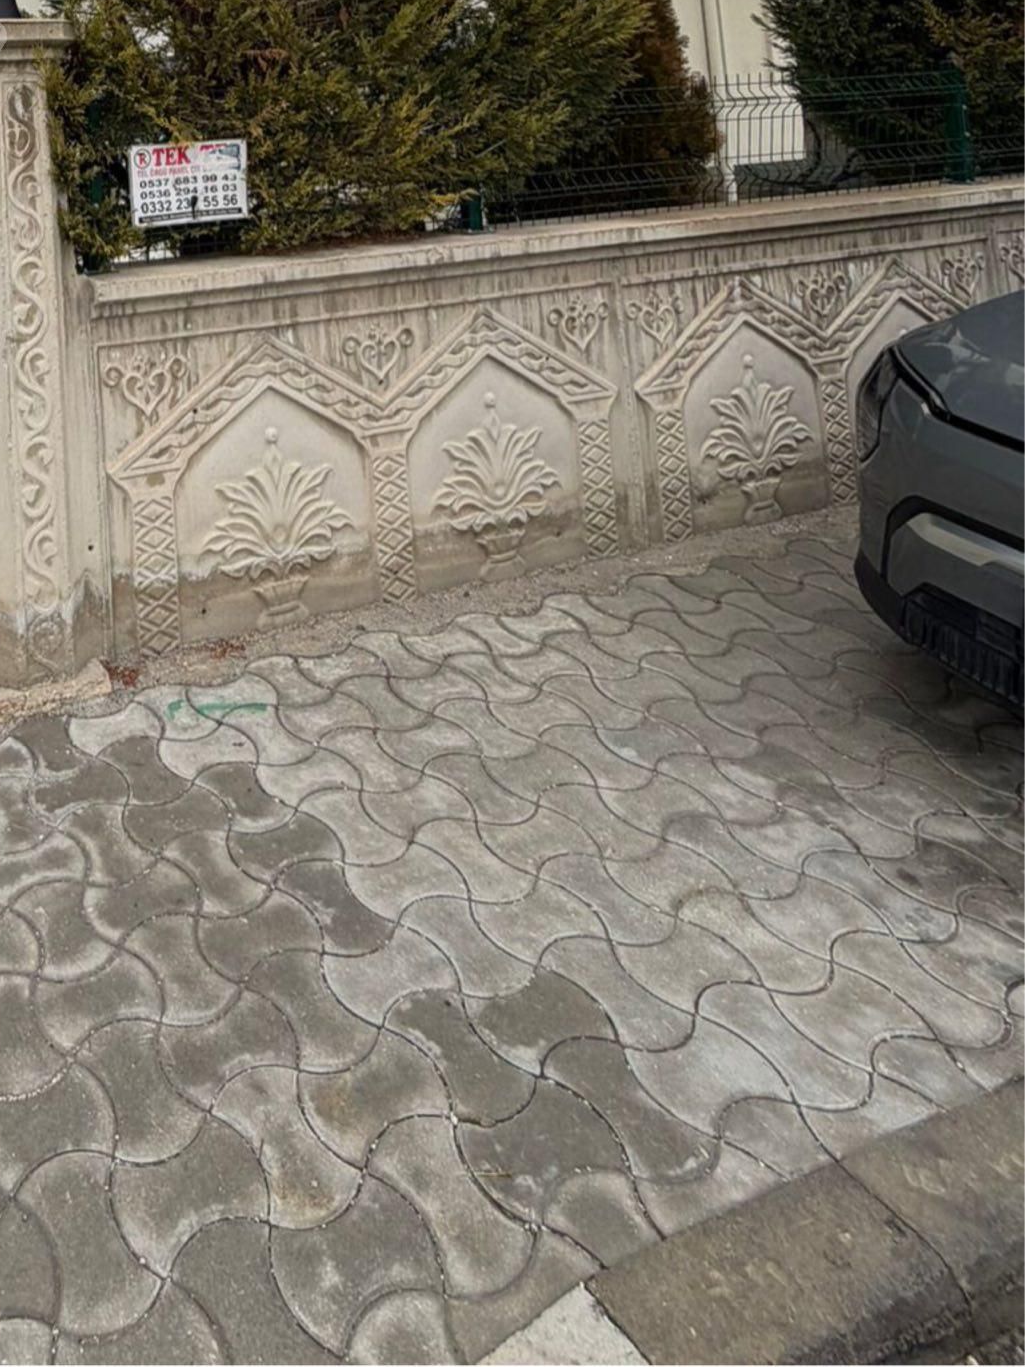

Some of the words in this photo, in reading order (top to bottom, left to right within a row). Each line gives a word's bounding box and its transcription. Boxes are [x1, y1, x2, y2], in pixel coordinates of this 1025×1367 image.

[152, 145, 191, 167] TEK
[222, 183, 237, 192] 03
[140, 199, 172, 214] 0332
[175, 195, 199, 211] 23
[203, 194, 219, 208] 55
[222, 193, 238, 207] 56
